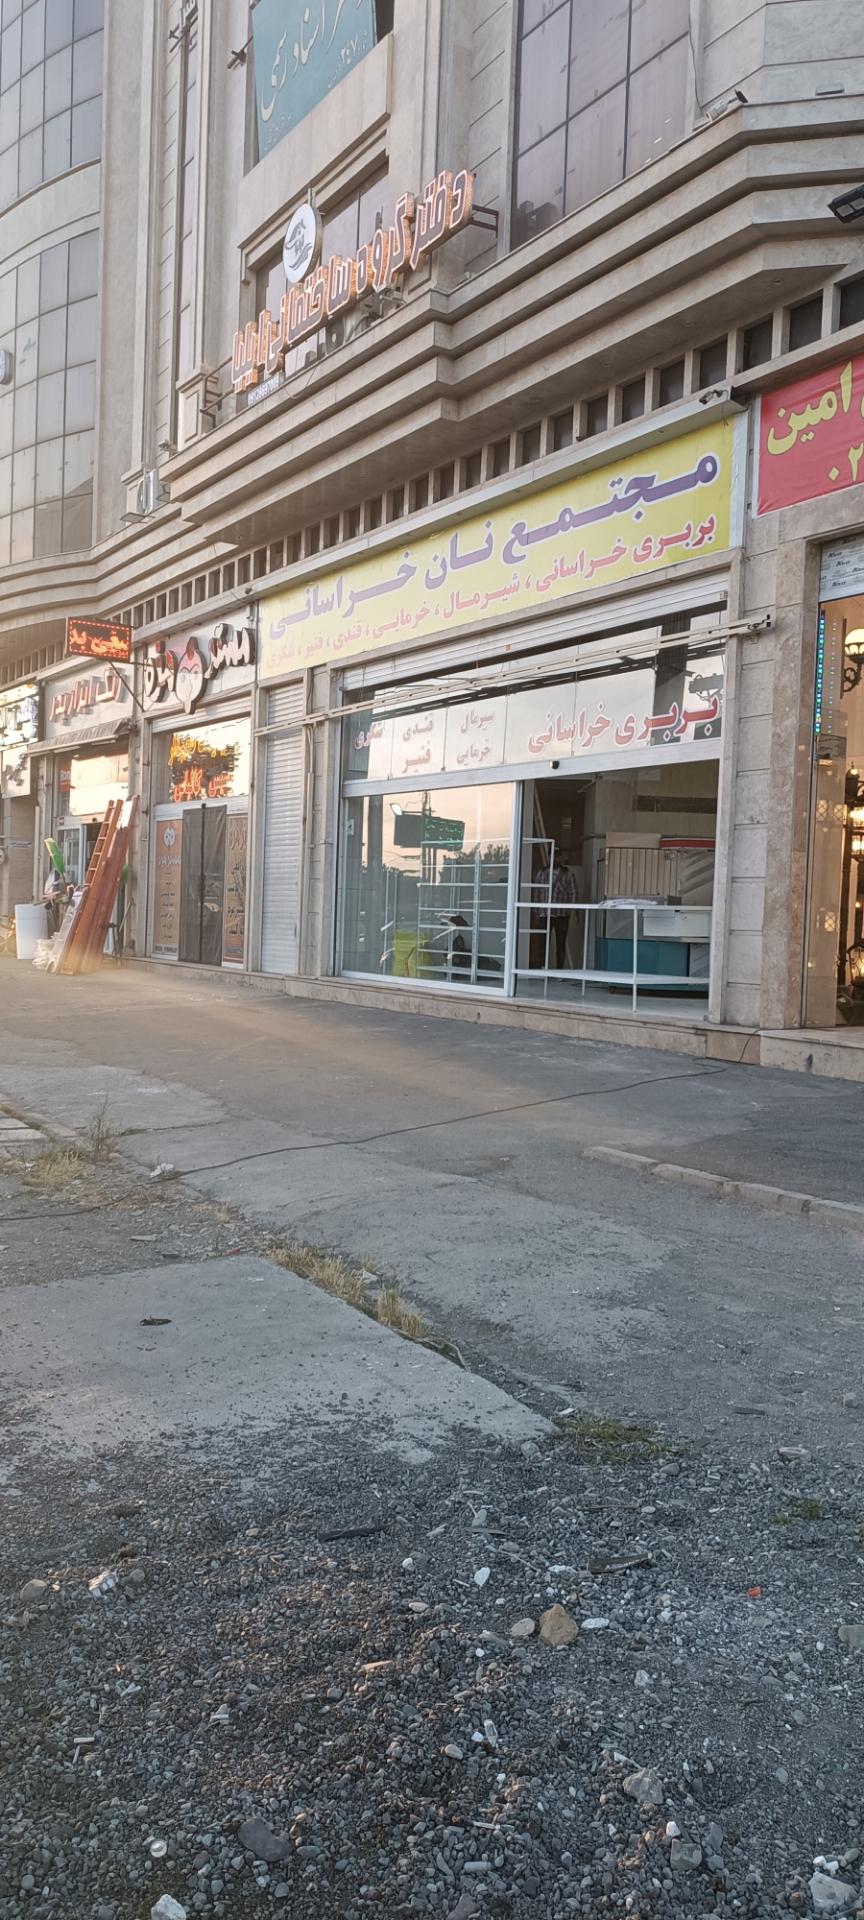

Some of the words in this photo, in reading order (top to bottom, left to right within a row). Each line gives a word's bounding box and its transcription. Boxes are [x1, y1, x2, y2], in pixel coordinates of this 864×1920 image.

[356, 192, 408, 294] گروه
[409, 169, 468, 272] دفتر
[265, 255, 353, 375] ساختمانی
[767, 360, 853, 456] امین
[501, 454, 718, 565] مجتمع
[633, 516, 715, 563] بربری
[268, 550, 418, 641] خراسانی
[424, 519, 494, 591] نان
[402, 713, 434, 742] قندی
[402, 741, 432, 774] فتیر
[528, 703, 611, 753] خراسانی
[613, 695, 719, 747] بربری
